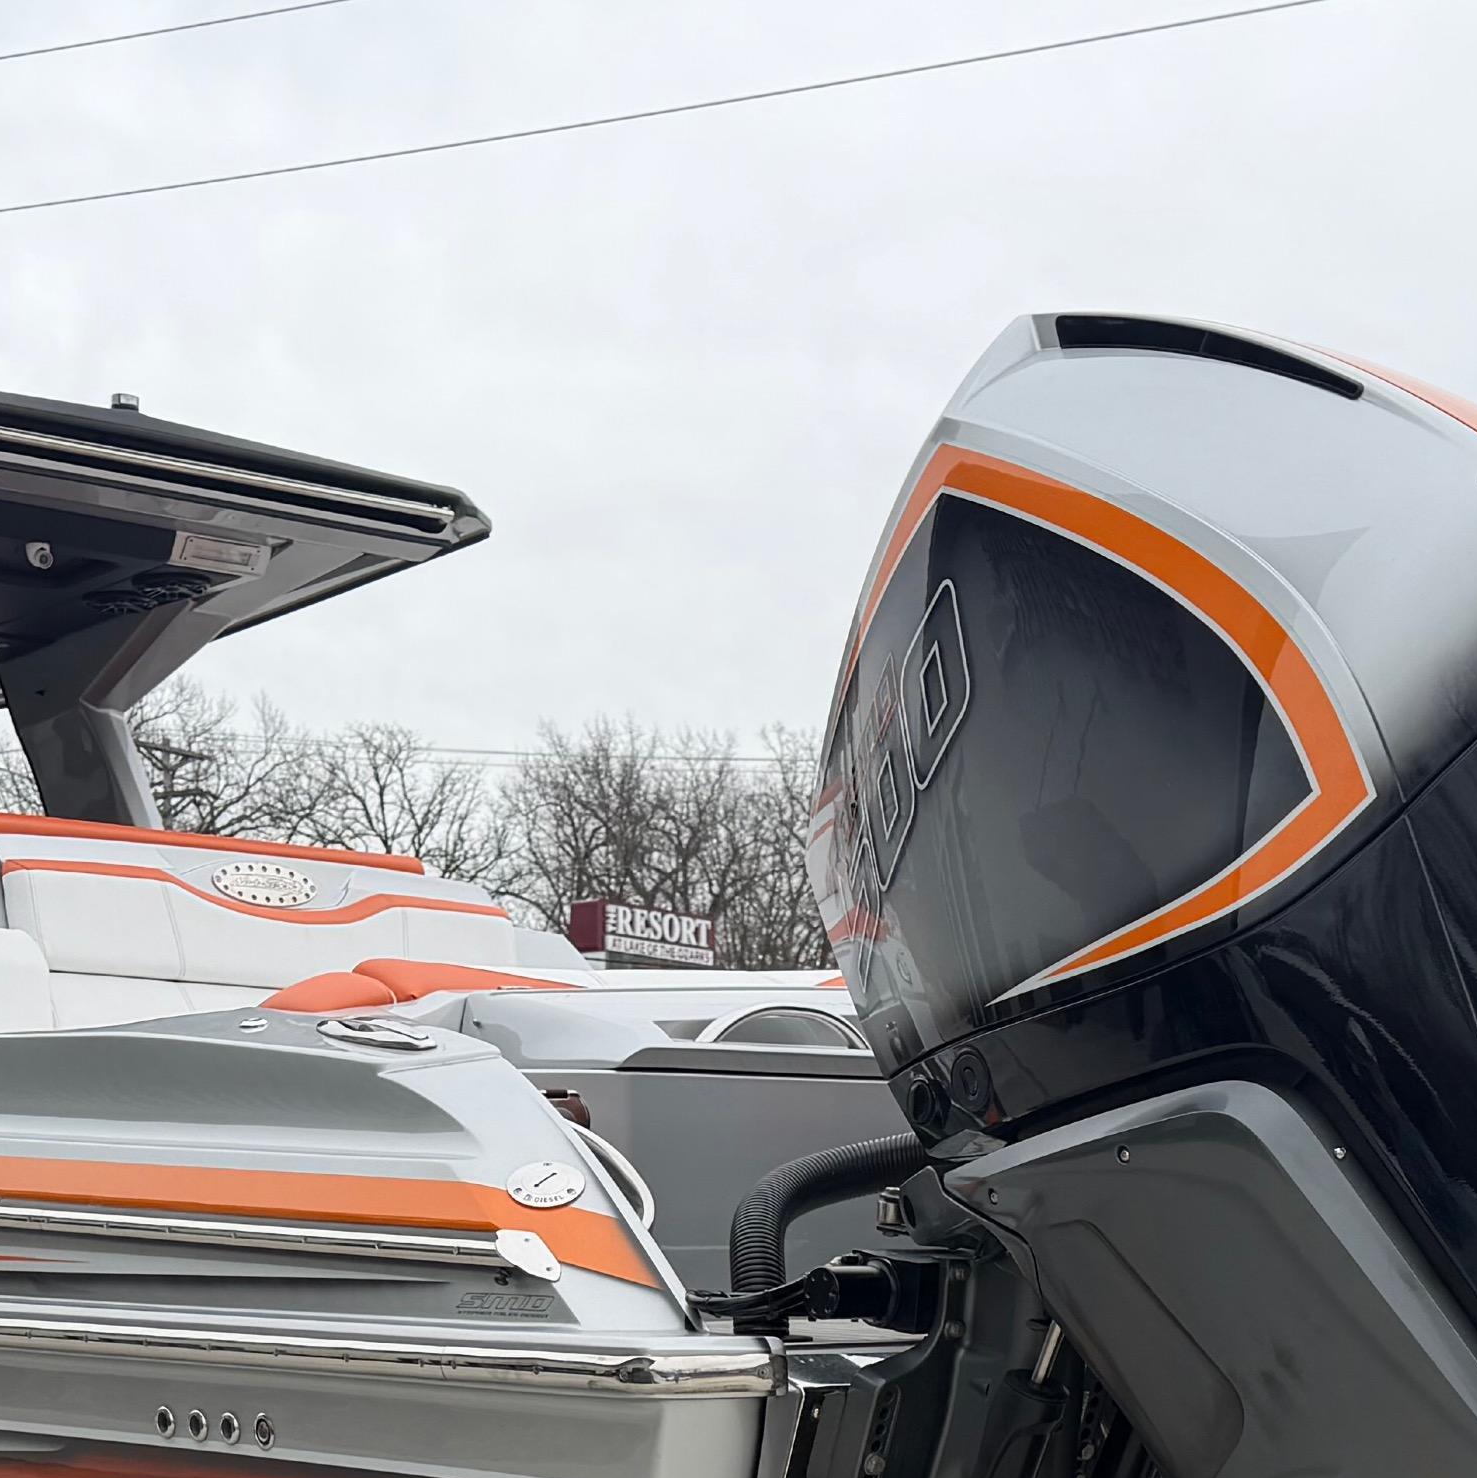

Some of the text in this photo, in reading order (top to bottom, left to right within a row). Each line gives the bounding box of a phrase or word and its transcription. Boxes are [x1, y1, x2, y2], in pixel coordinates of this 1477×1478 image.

[838, 579, 971, 994] 500
[615, 905, 712, 948] RESORT
[612, 937, 623, 948] AT
[623, 940, 645, 955] LAKE
[647, 943, 659, 956] OF
[676, 947, 710, 964] OZARKS
[534, 1194, 564, 1204] DIESEL
